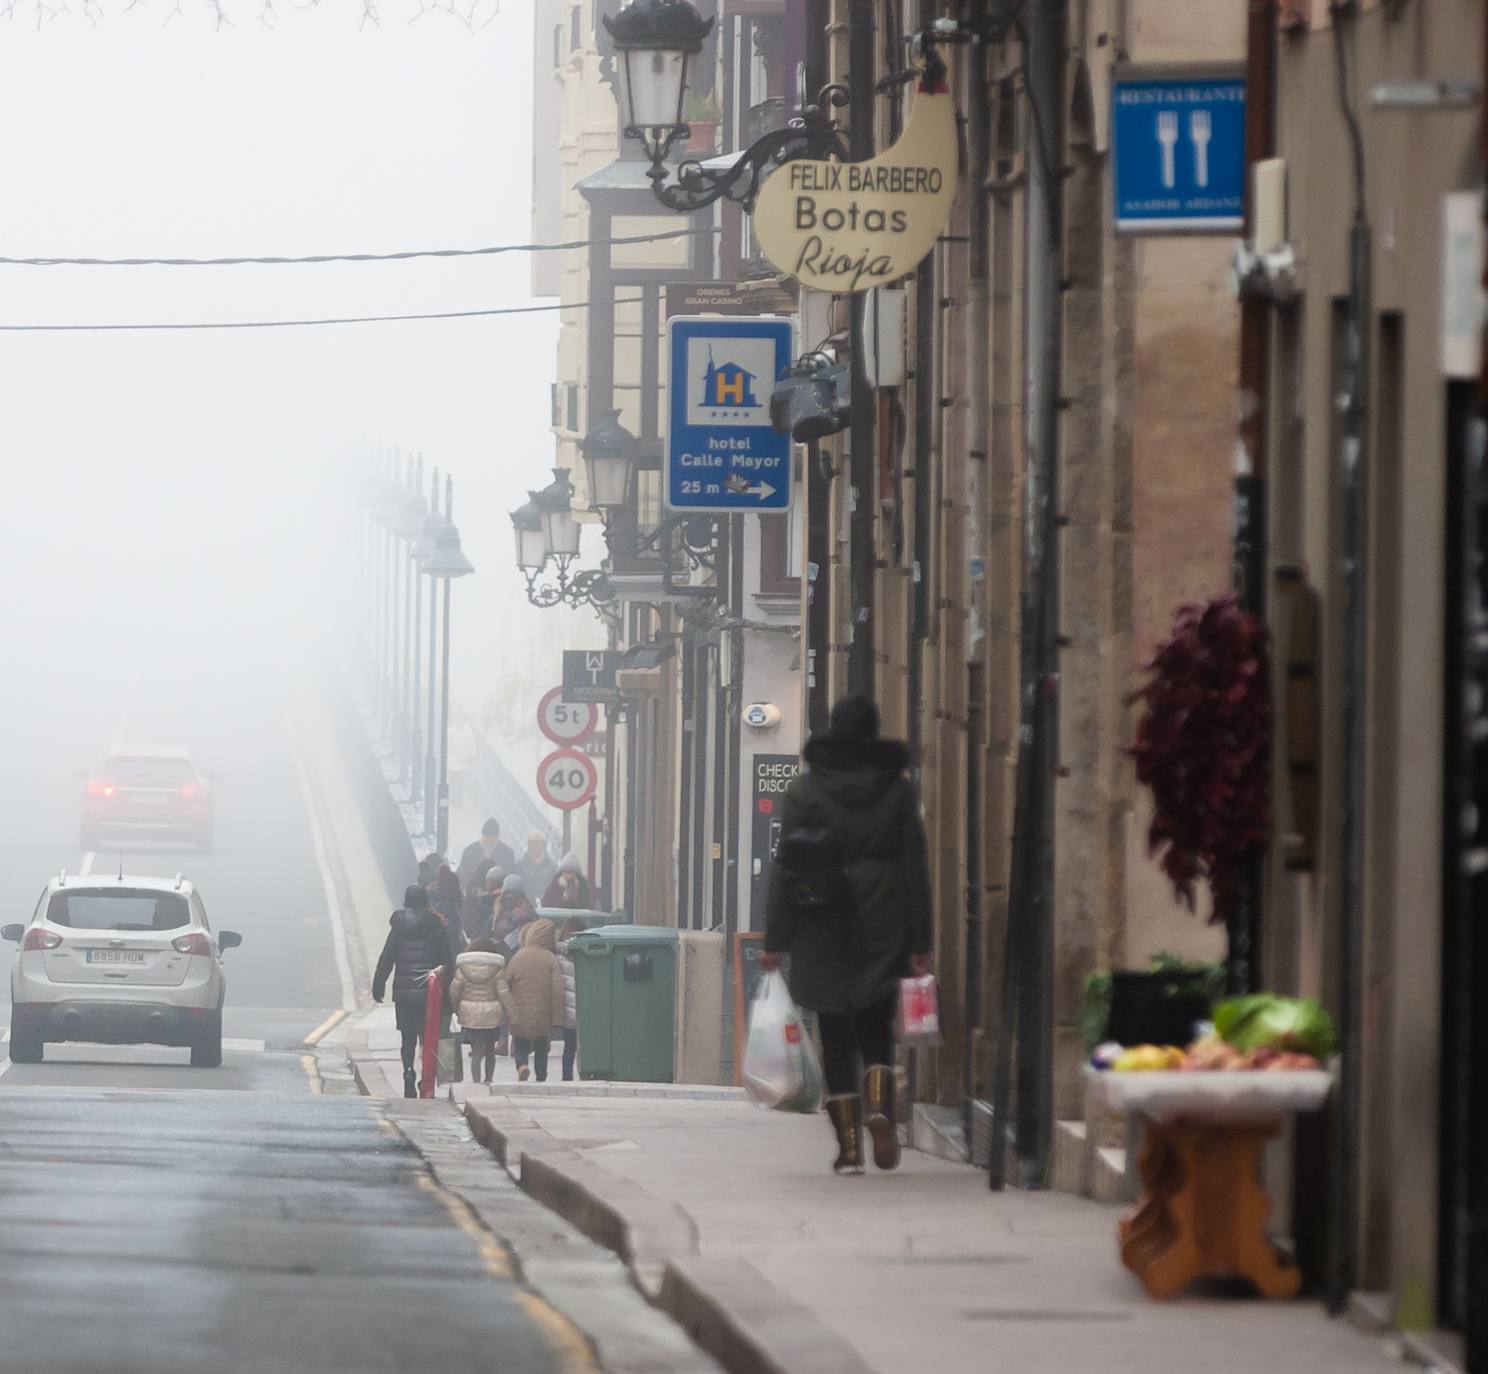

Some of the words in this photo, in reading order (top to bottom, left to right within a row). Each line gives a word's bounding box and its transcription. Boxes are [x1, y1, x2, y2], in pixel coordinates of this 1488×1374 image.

[790, 165, 842, 191] FELIX
[848, 167, 943, 194] BARBERO
[795, 195, 908, 233] Botas
[794, 235, 895, 291] Rioja
[684, 297, 710, 306] GRAN
[710, 297, 743, 306] CASINO
[709, 436, 751, 450] hotel
[680, 453, 724, 467] Calle
[731, 454, 781, 470] Mayor
[681, 480, 702, 494] 25
[706, 483, 720, 494] m
[758, 763, 800, 777] CHECK
[548, 769, 585, 789] 40
